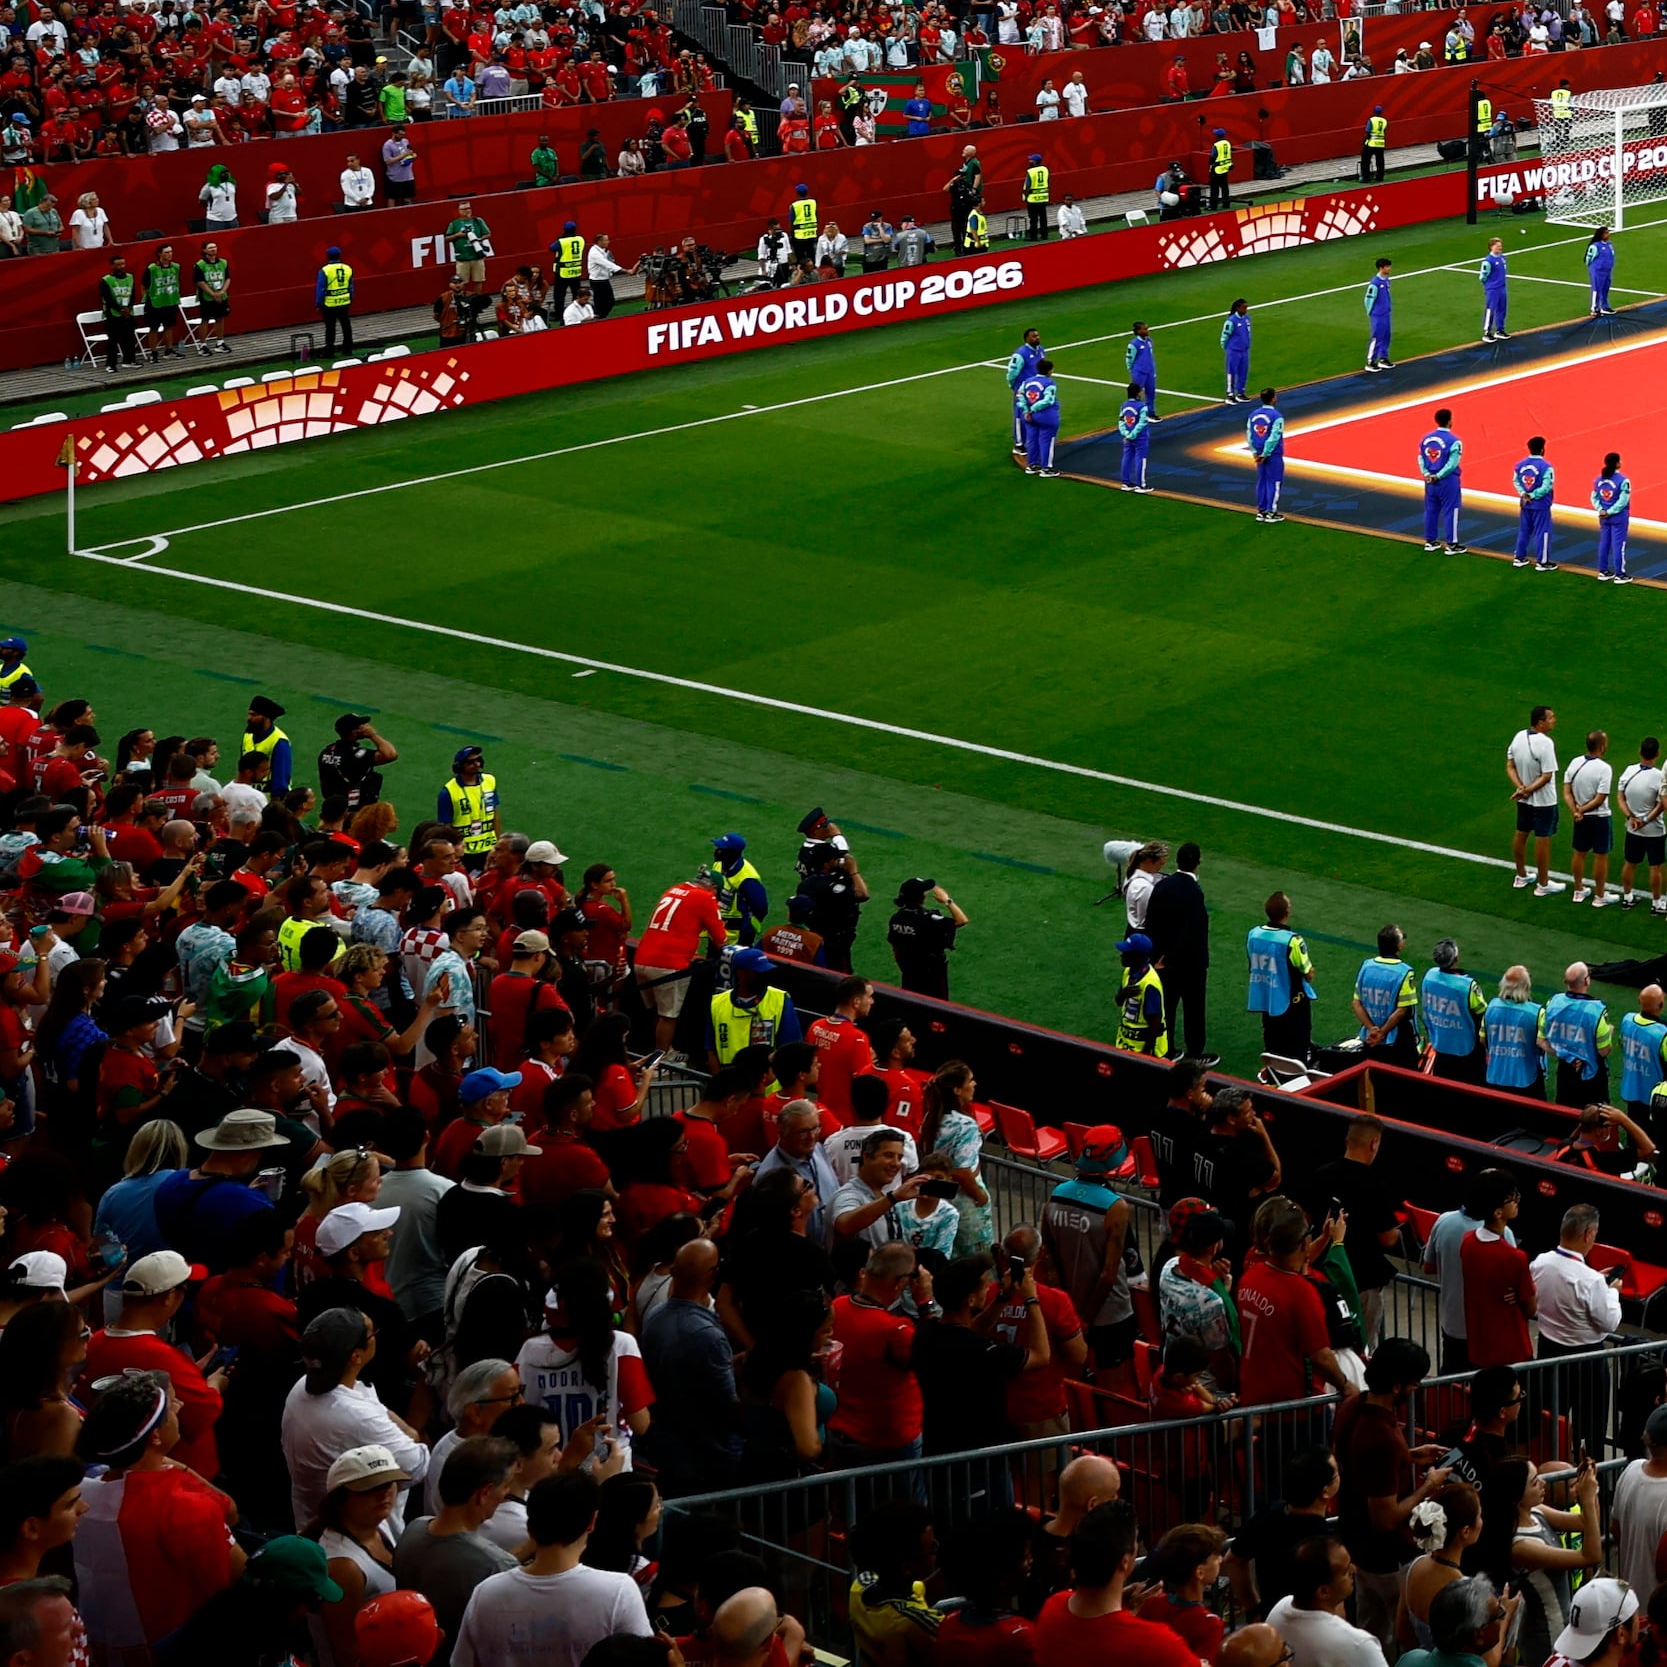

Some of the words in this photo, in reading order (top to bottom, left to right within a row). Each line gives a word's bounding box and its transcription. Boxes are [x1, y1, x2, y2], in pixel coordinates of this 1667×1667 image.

[1478, 172, 1521, 201] FIFA
[1524, 158, 1595, 192] WORLD
[648, 317, 724, 355] FIFA
[727, 289, 848, 339] WORLD
[853, 279, 915, 317] CUP
[920, 261, 1024, 305] 2026
[648, 896, 682, 932] 21
[771, 935, 805, 952] PARTNER
[776, 929, 803, 943] MEDIA
[1423, 991, 1461, 1017] FIFA
[1490, 1021, 1527, 1045] FIFA
[1550, 1020, 1588, 1045] FIFA
